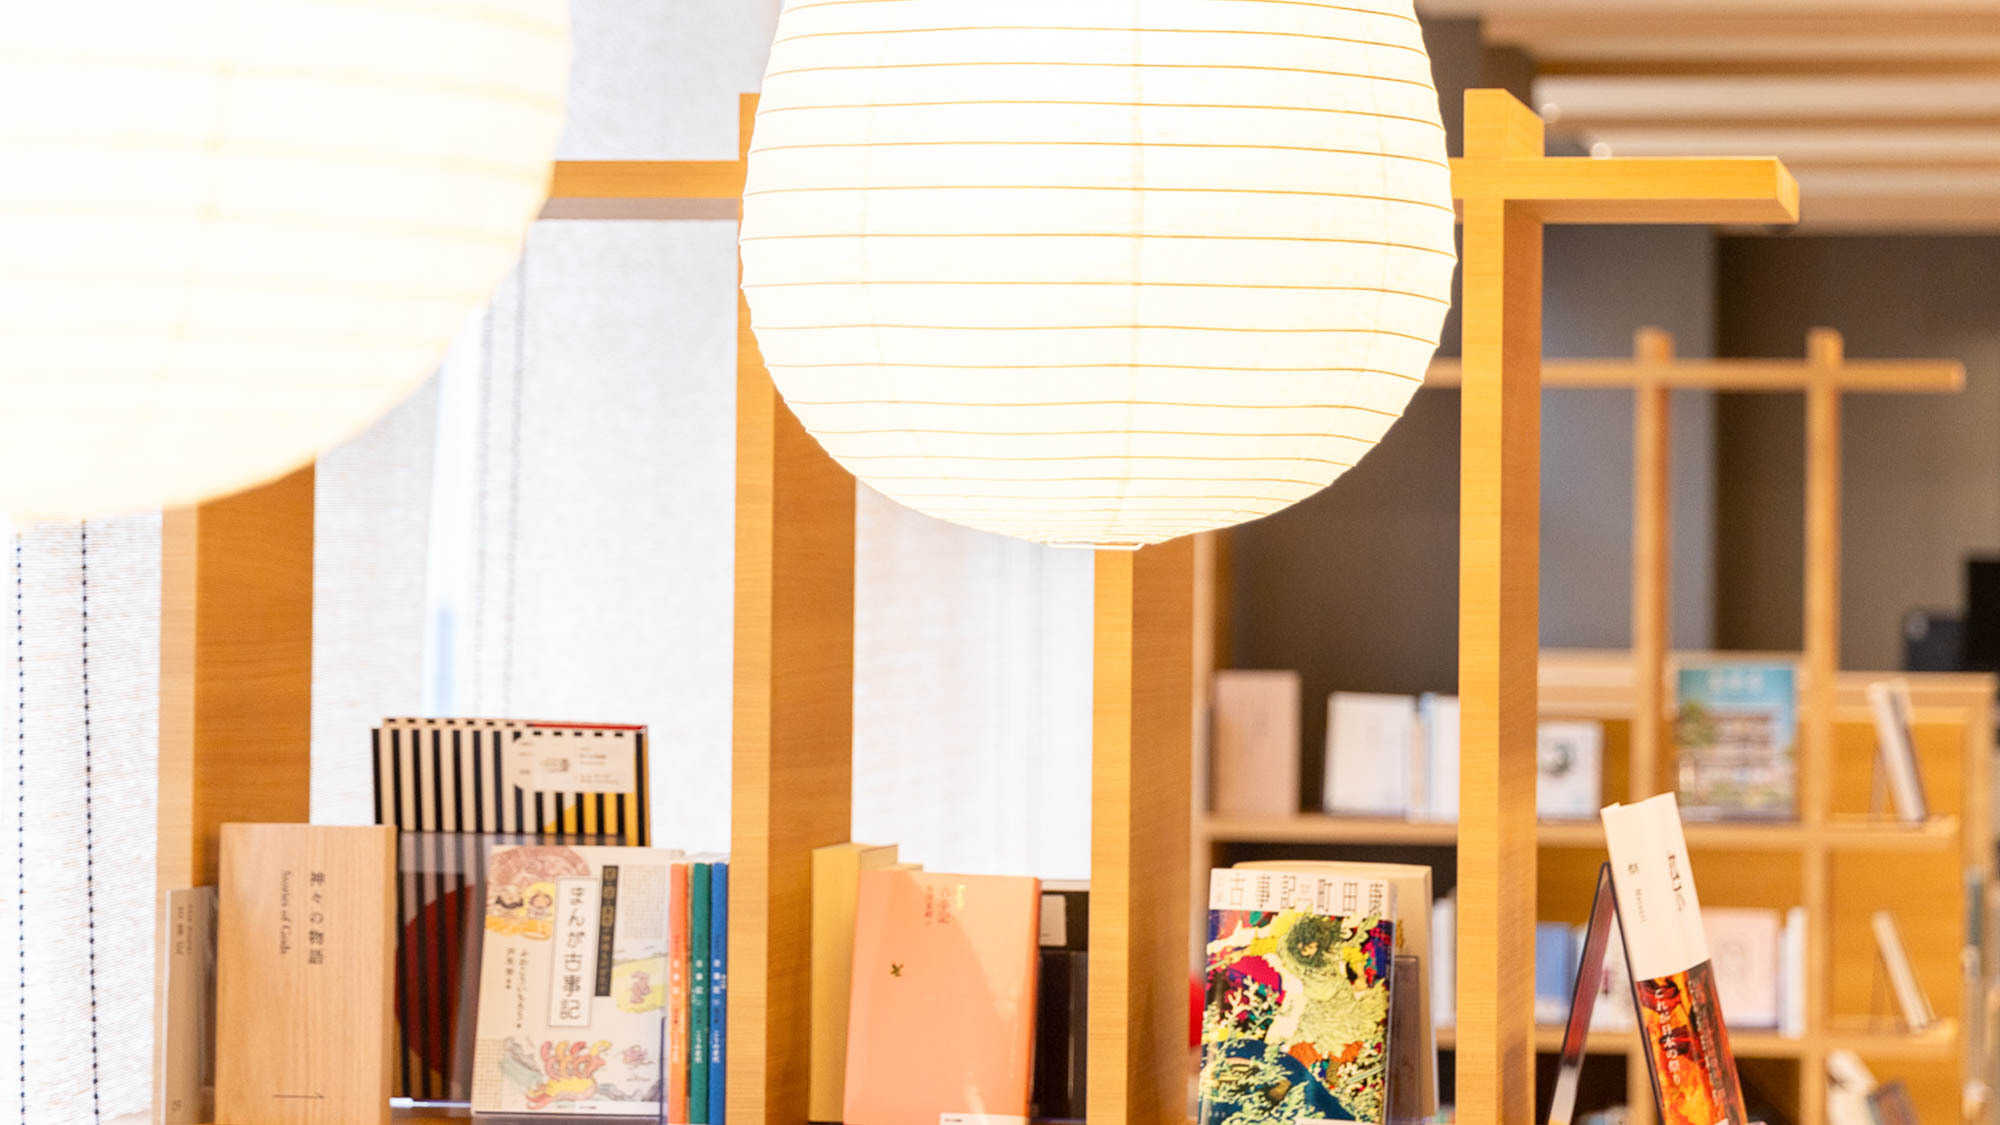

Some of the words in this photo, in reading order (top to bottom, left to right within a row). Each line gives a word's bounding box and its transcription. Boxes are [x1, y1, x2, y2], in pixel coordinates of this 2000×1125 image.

[1231, 872, 1297, 910] 古事記
[558, 886, 587, 1021] まんが古事記
[1653, 987, 1682, 1086] これが日本の祭り
